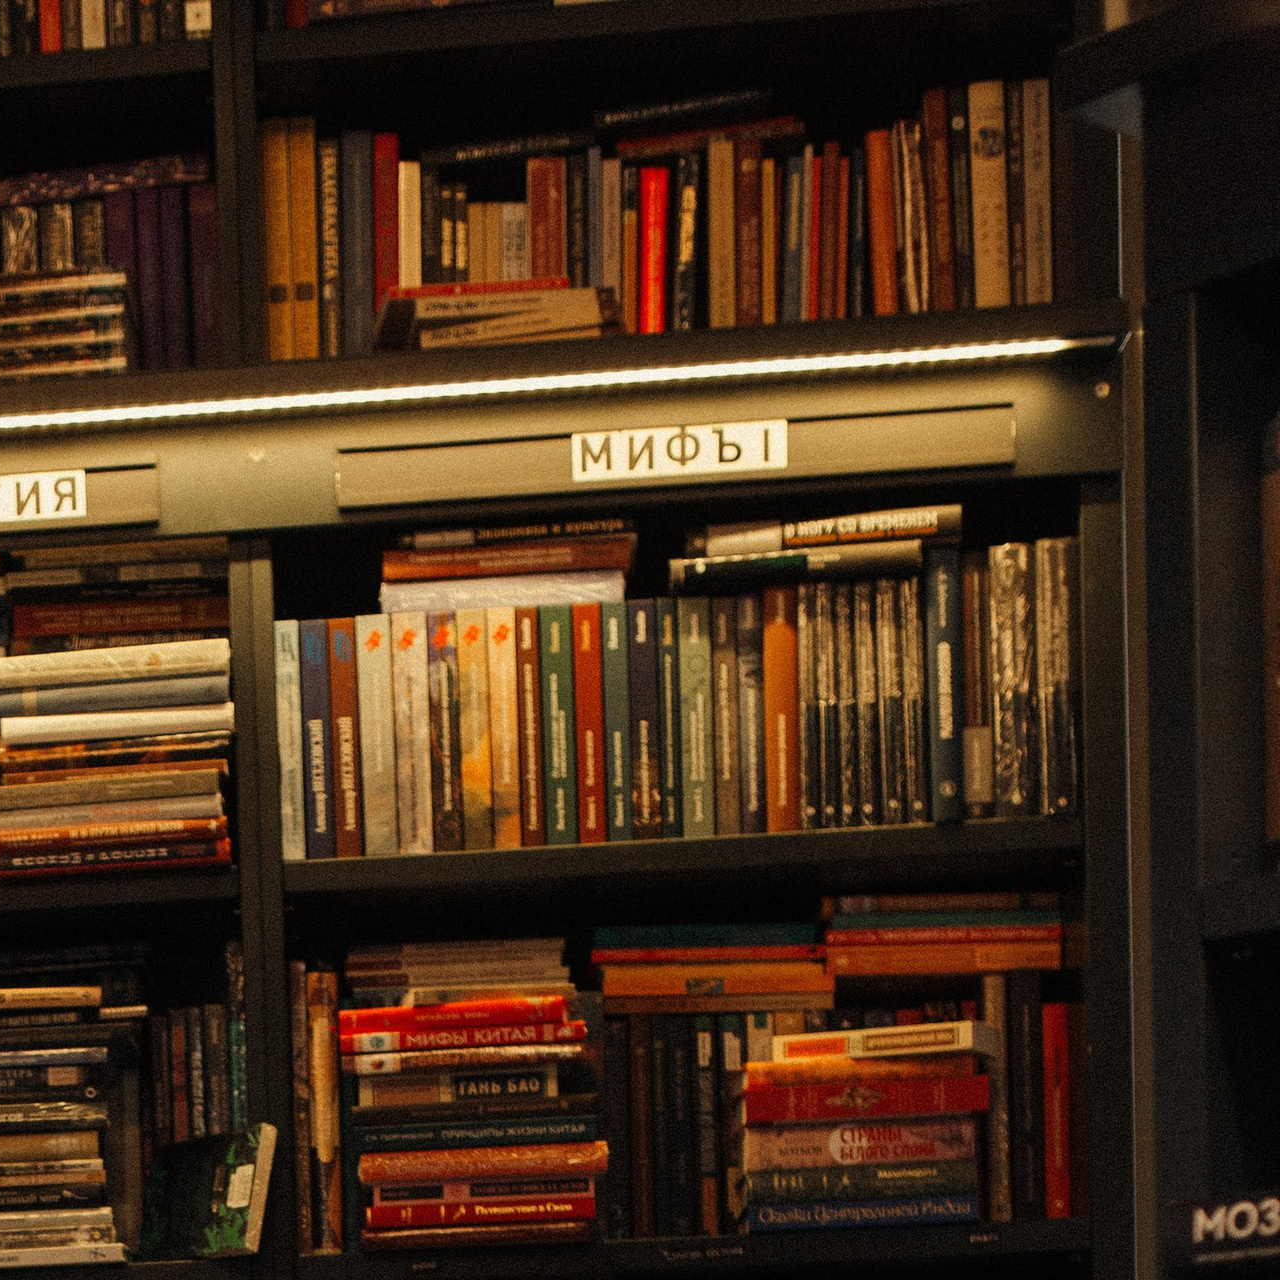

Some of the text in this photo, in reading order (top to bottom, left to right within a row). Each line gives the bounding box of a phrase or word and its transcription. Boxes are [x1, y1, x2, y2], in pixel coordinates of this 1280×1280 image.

[406, 1026, 537, 1047] МИФЫ КИТАЯ
[506, 1077, 541, 1095] БАО
